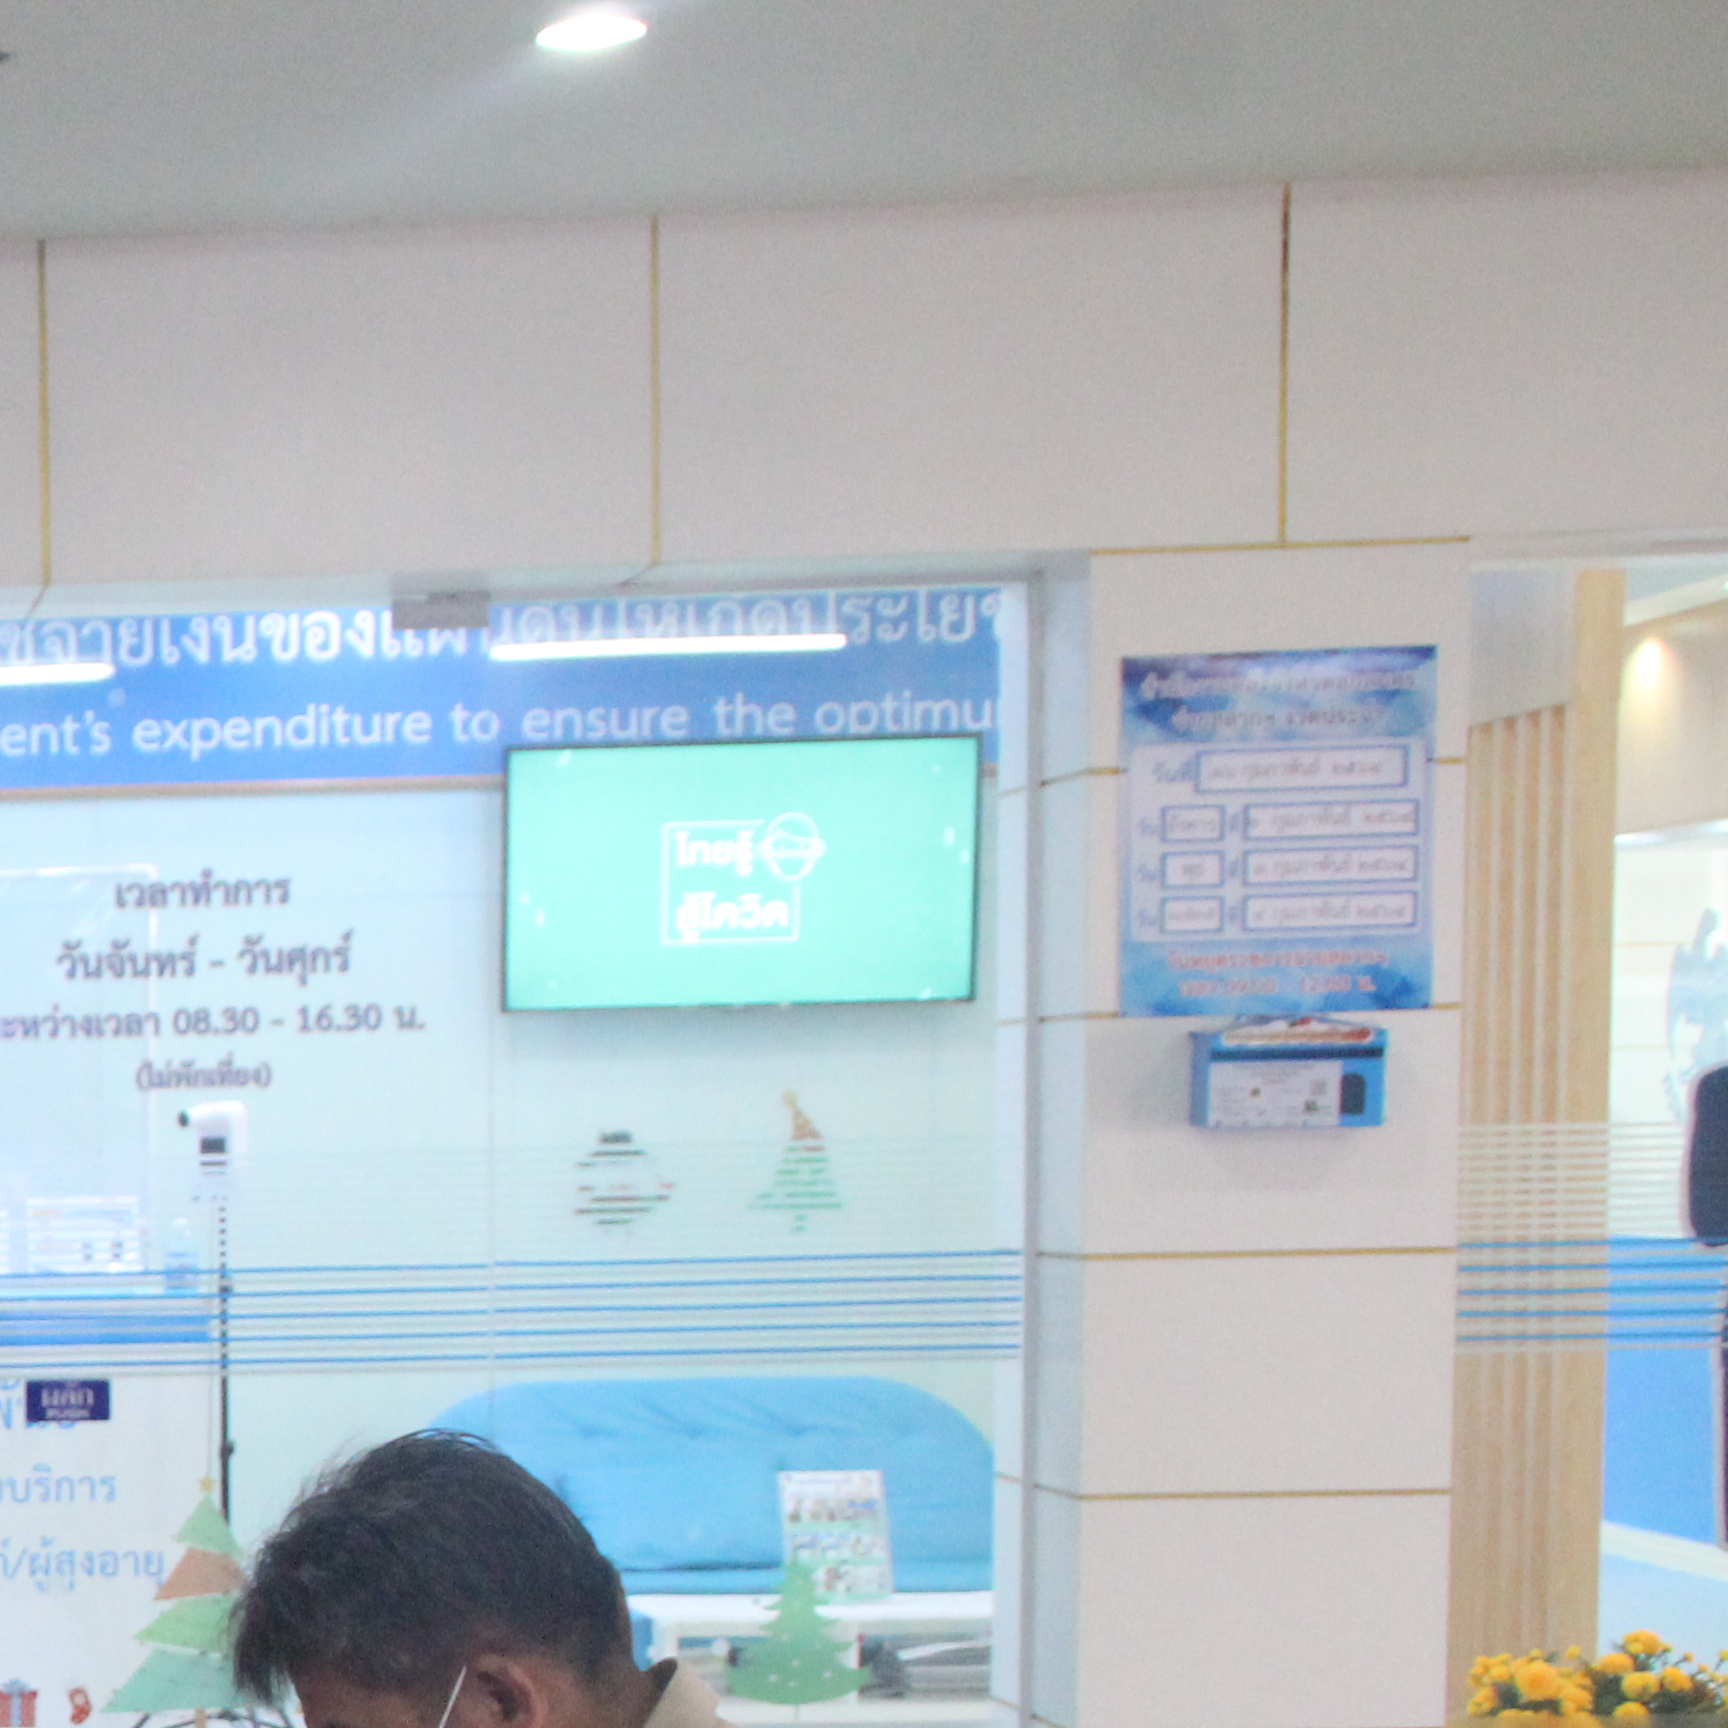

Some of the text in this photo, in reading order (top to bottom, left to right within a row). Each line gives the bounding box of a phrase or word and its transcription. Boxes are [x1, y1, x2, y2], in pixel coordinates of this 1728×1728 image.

[132, 702, 433, 763] expenditure
[448, 702, 501, 744] to
[521, 704, 689, 740] ensure
[714, 692, 798, 736] the
[115, 867, 291, 909] เวลาทำการ
[57, 933, 200, 981] วันจันทร์
[238, 929, 353, 986] วันศุกร์
[173, 1006, 260, 1036] 08.30
[297, 1002, 382, 1032] 16.30
